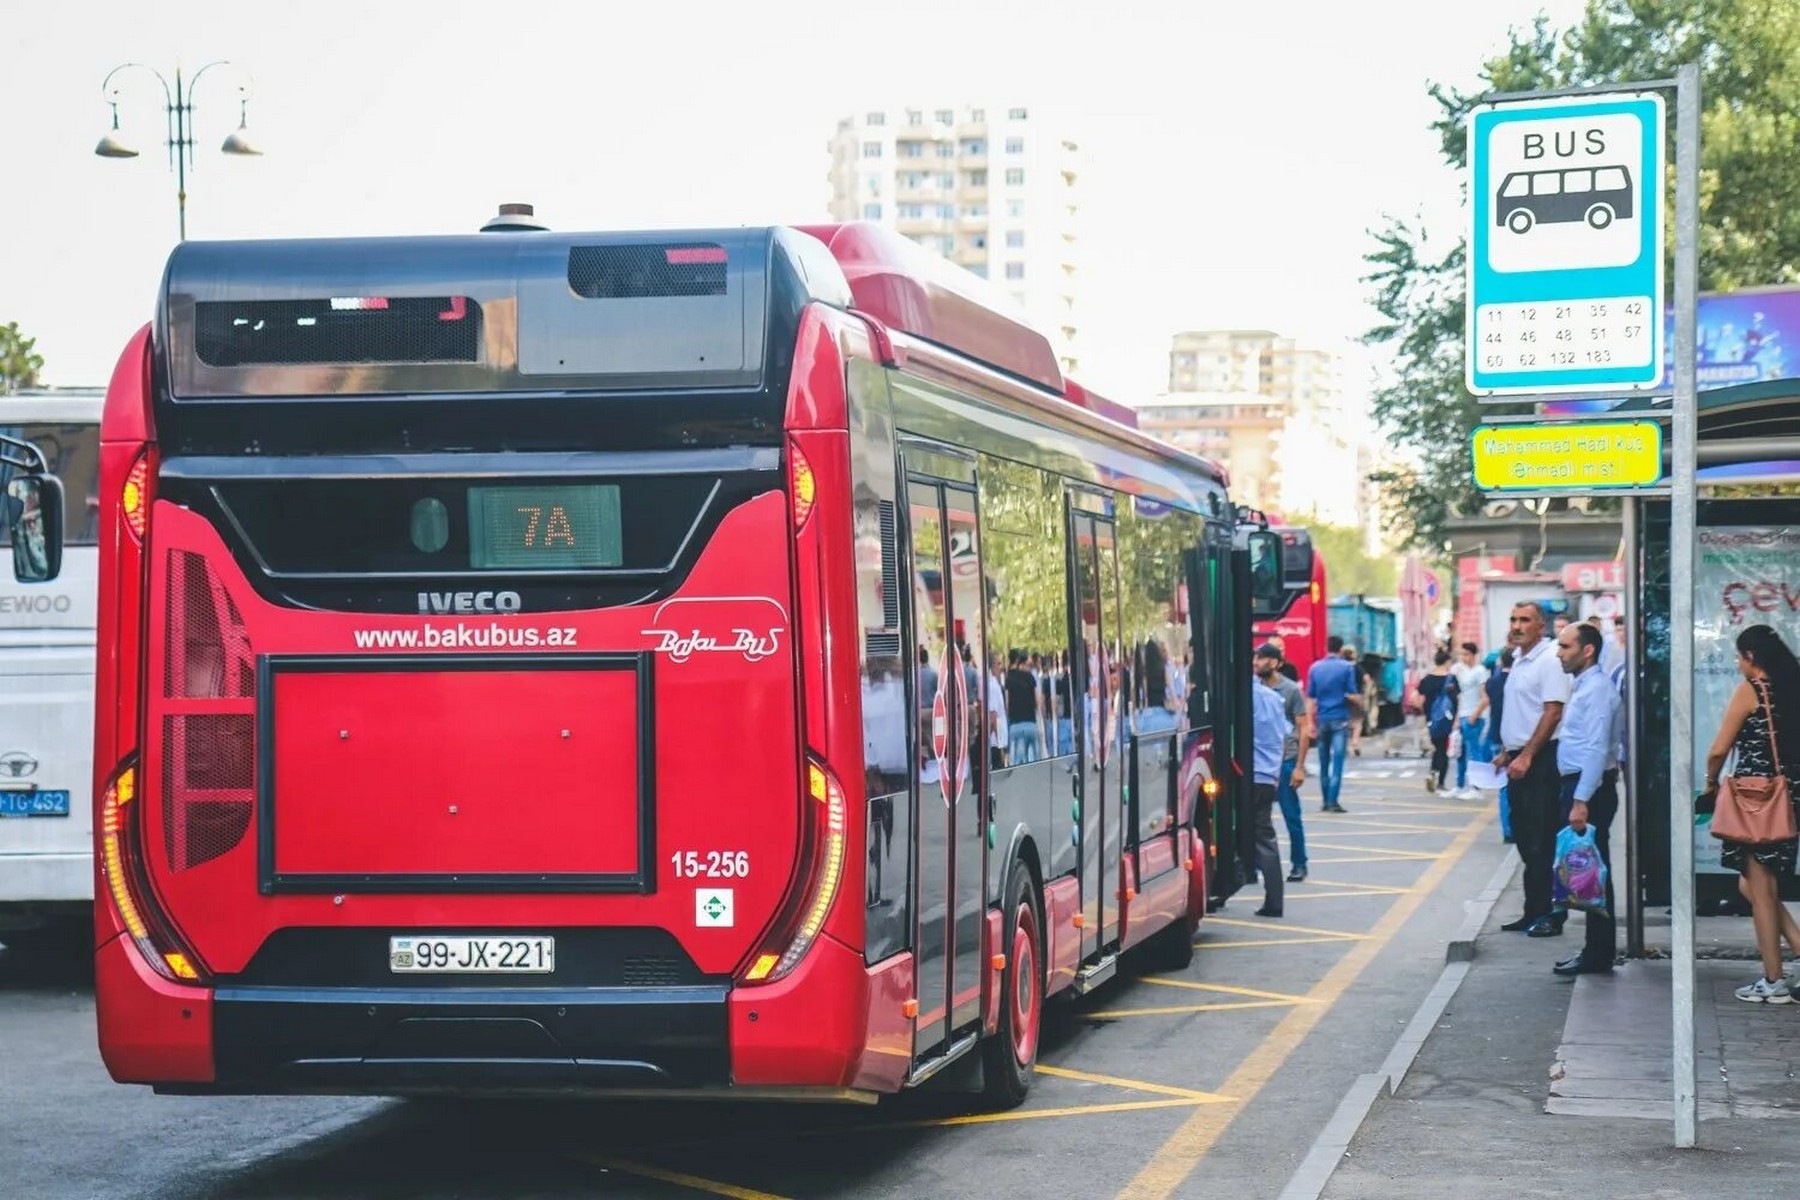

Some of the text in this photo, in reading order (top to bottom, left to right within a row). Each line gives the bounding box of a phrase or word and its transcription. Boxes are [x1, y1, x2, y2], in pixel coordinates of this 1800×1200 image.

[1524, 129, 1605, 159] BUS
[1488, 303, 1642, 322] 11 12 21 35 42
[1485, 326, 1642, 343] 44 46 48 51 57
[1487, 350, 1611, 367] 60 62 132 183
[518, 506, 574, 546] 7A
[418, 591, 521, 614] IVECO
[354, 623, 577, 648] www.bakubus.az
[671, 851, 749, 877] 15-256
[417, 941, 543, 967] 99-JX-221
